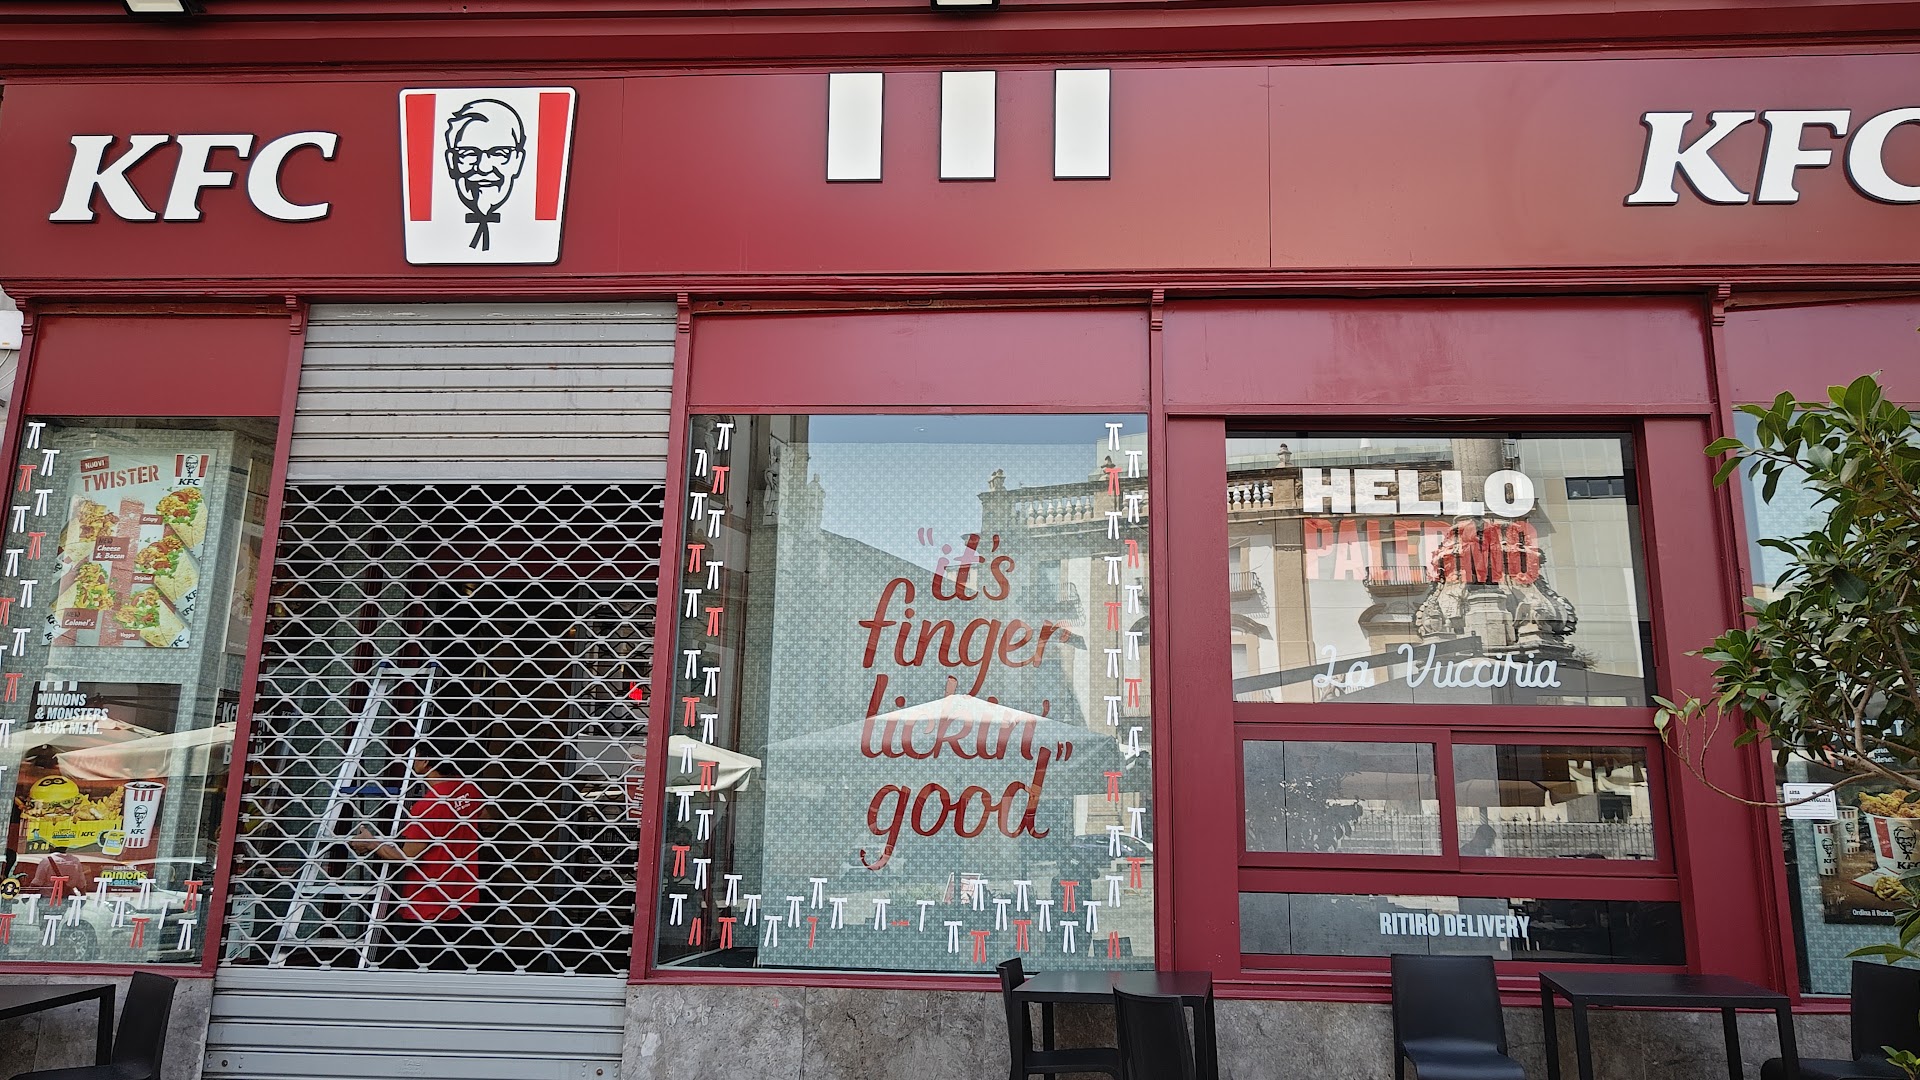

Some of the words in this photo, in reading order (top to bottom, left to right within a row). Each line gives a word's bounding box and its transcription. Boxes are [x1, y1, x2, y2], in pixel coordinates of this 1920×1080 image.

[1624, 107, 1920, 206] KFC
[48, 131, 340, 223] KFC
[84, 459, 106, 470] NUOVI
[82, 465, 160, 492] TWISTER
[178, 478, 200, 486] KFC
[1302, 468, 1535, 518] HELLO
[1303, 518, 1542, 586] PALERMO
[134, 574, 153, 583] Original
[64, 619, 95, 627] Colonel's
[858, 577, 1072, 697] finger
[1313, 644, 1375, 688] La
[1397, 643, 1562, 689] Vucciria
[36, 693, 87, 706] MINIONS
[34, 706, 44, 720] &
[46, 707, 109, 720] MONSTERS
[32, 721, 42, 734] &
[44, 721, 67, 734] BOX
[101, 870, 148, 881] minions
[1852, 908, 1872, 917] Ordina
[1379, 912, 1441, 937] RITIRO
[1443, 914, 1531, 939] DELIVERY
